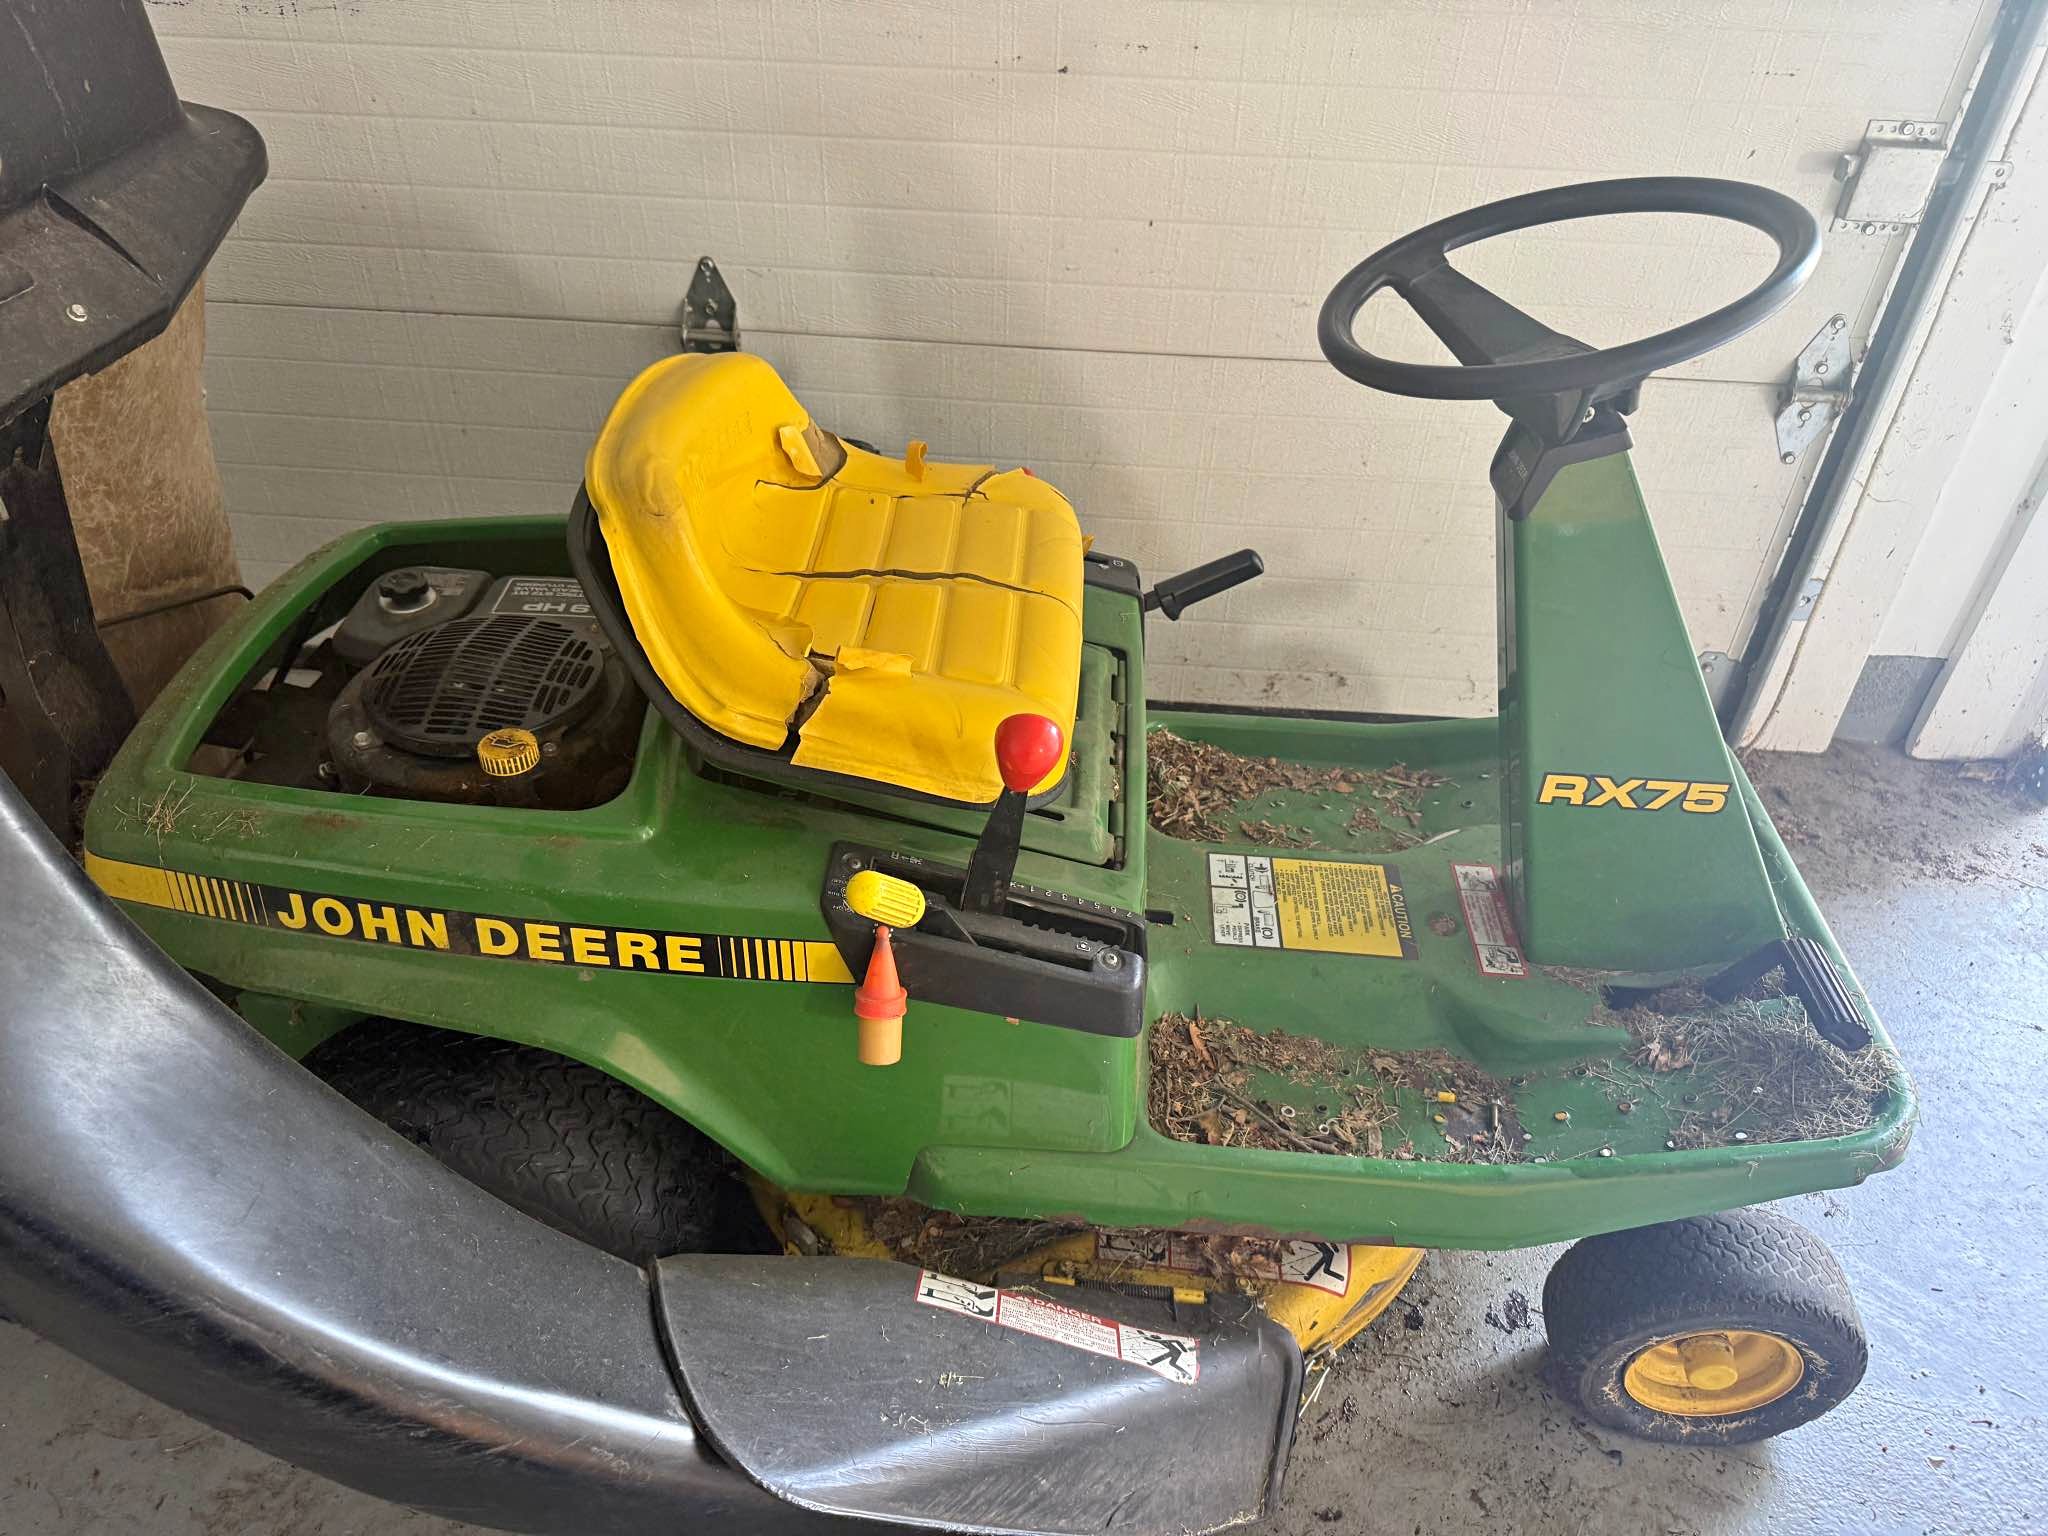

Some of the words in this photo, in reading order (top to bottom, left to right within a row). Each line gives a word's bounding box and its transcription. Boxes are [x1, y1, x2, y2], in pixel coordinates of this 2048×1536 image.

[522, 602, 566, 613] HP
[570, 604, 590, 614] 9
[1537, 772, 1732, 815] RX75
[276, 892, 450, 950] JOHN
[476, 917, 706, 974] DEERE
[1392, 894, 1412, 938] CAUTION
[1030, 1297, 1104, 1325] DANGER
